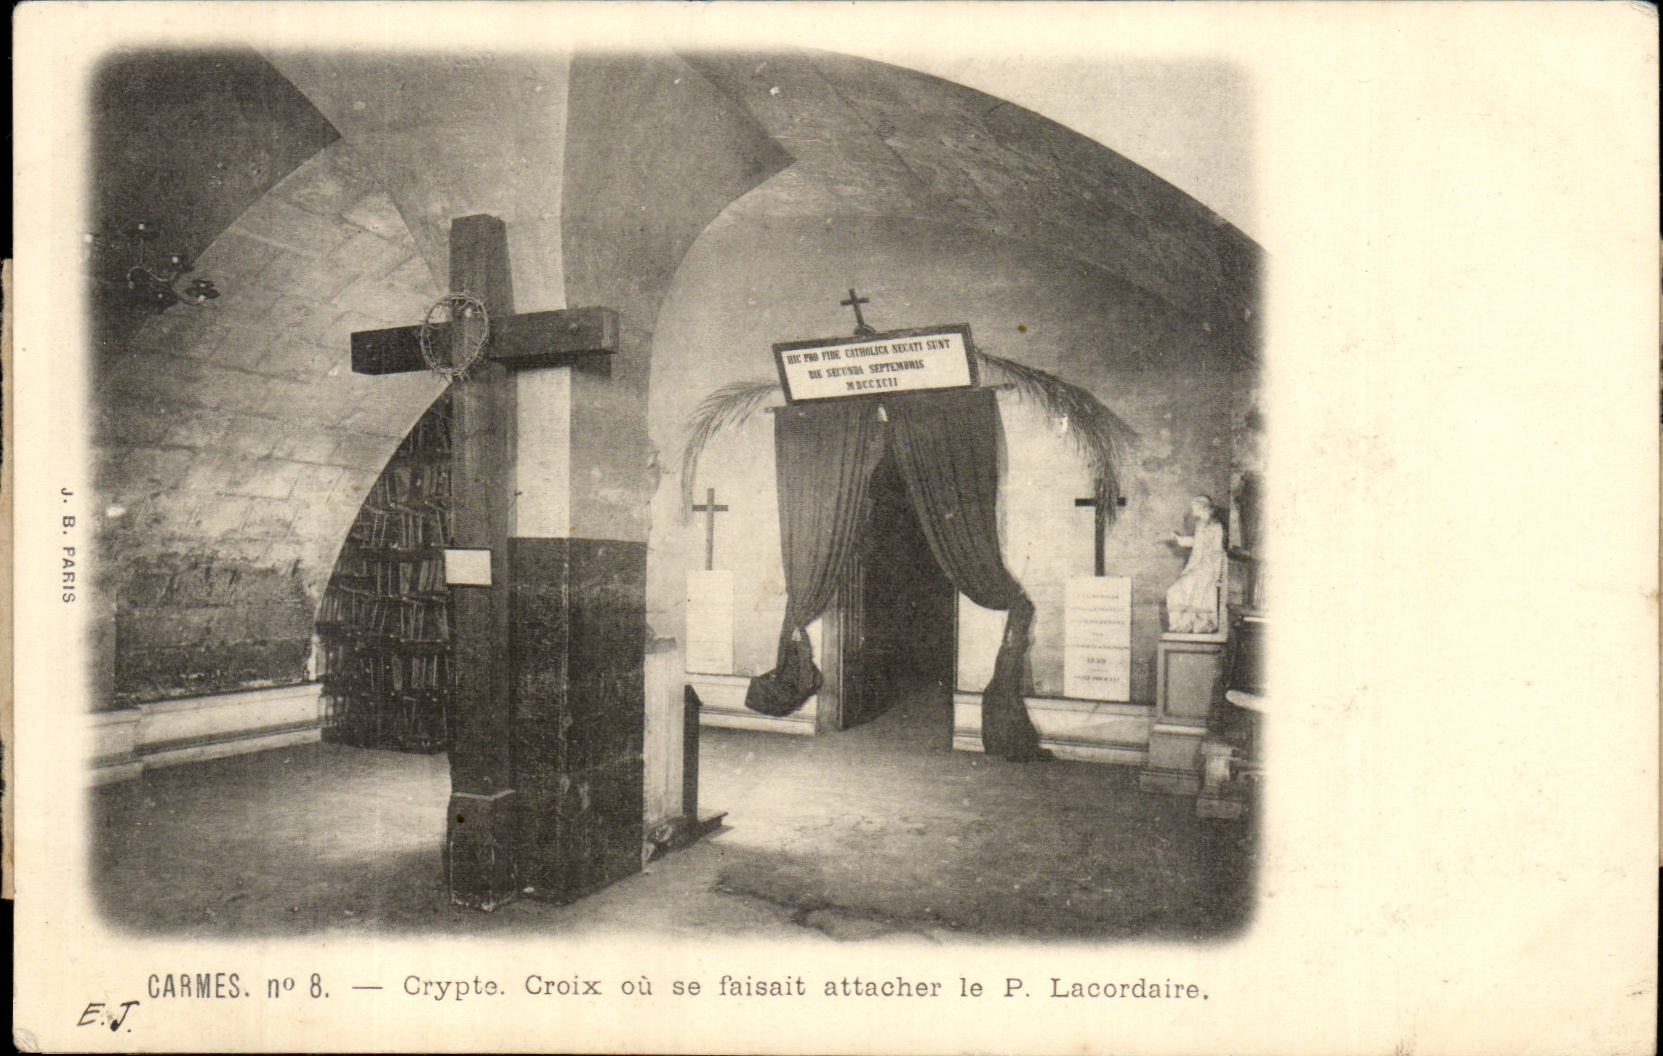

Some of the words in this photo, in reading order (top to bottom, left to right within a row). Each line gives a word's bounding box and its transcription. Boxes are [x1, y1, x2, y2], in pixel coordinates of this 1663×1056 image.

[787, 354, 802, 365] HIC
[803, 352, 819, 363] PRO
[822, 349, 841, 361] FIDE
[844, 345, 889, 358] CATHOLICA
[892, 341, 923, 354] NECATI
[926, 339, 951, 350] SUNT
[808, 369, 823, 379] DIE
[826, 365, 864, 378] SECUNDA
[869, 360, 925, 374] SEPTEMBRIS
[846, 377, 899, 391] MDCCXCII
